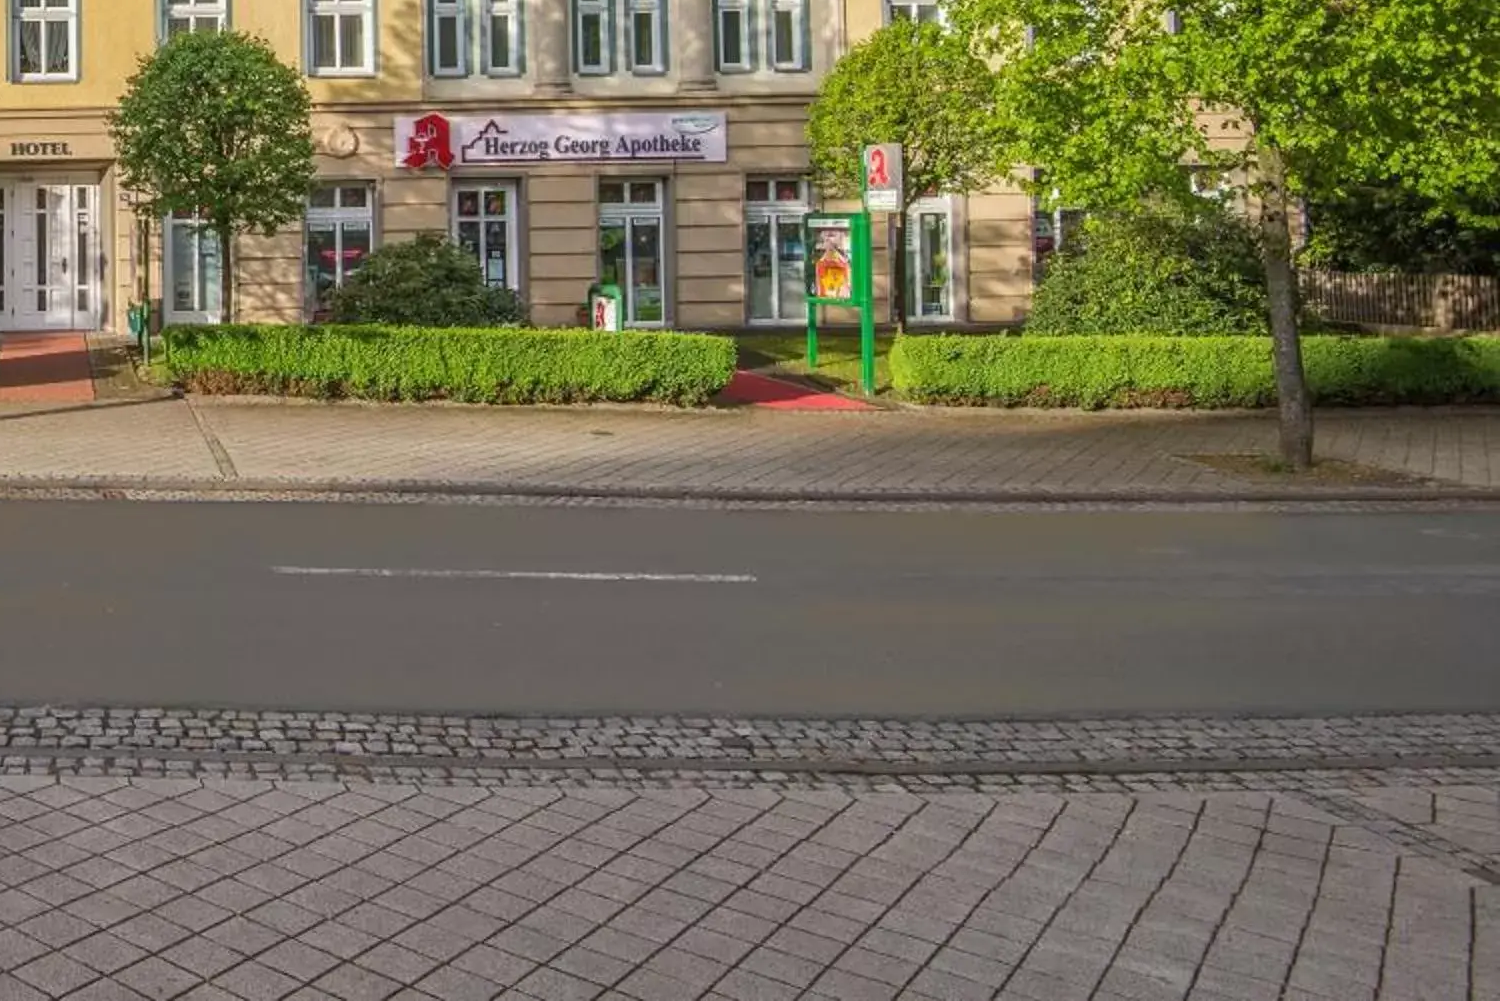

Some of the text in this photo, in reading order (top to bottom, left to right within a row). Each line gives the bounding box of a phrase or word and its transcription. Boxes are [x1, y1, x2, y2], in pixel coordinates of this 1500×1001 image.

[10, 142, 73, 156] HOTEL
[484, 134, 702, 159] Herzog Georg Apotheke
